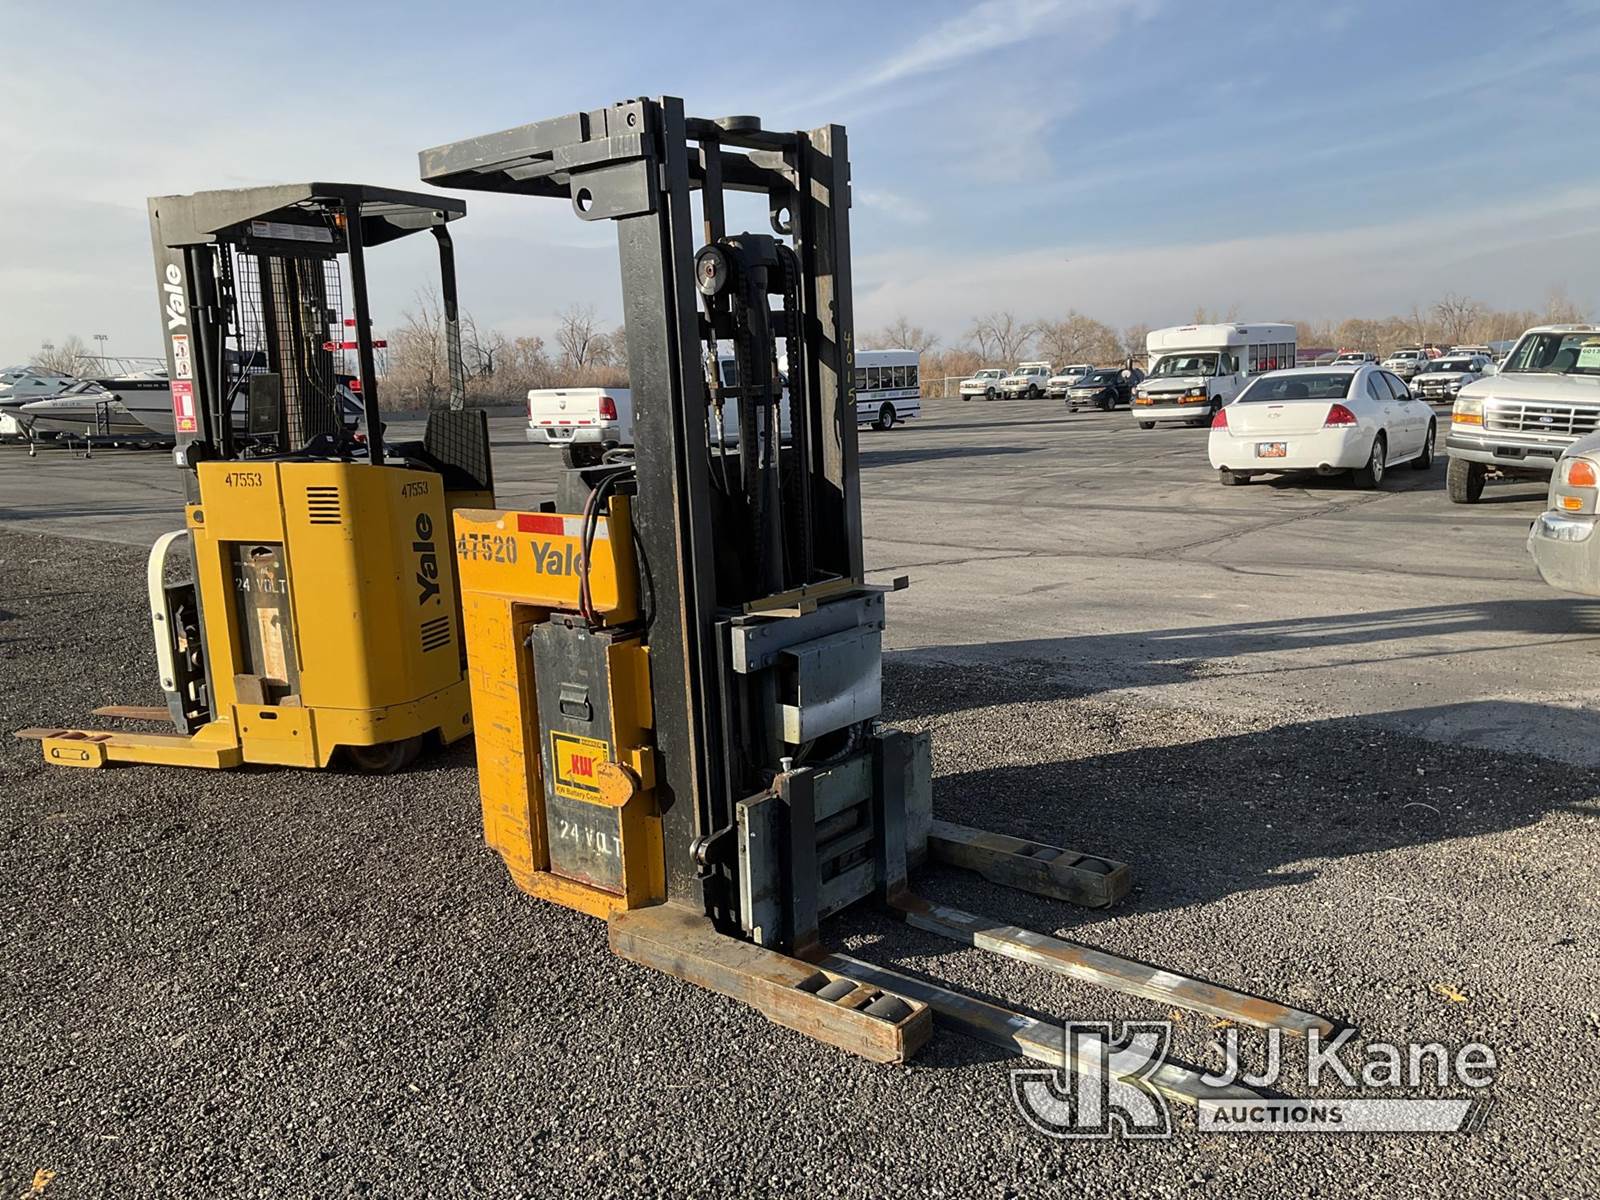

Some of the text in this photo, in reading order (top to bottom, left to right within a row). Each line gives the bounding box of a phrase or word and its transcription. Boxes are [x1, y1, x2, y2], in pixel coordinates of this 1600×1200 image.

[163, 263, 187, 330] Yale
[225, 472, 262, 487] 47553
[401, 481, 429, 498] 47553
[413, 512, 440, 606] Yale
[458, 533, 591, 577] 47520 Yale
[235, 577, 286, 594] 24 VOLT
[560, 820, 578, 842] 24
